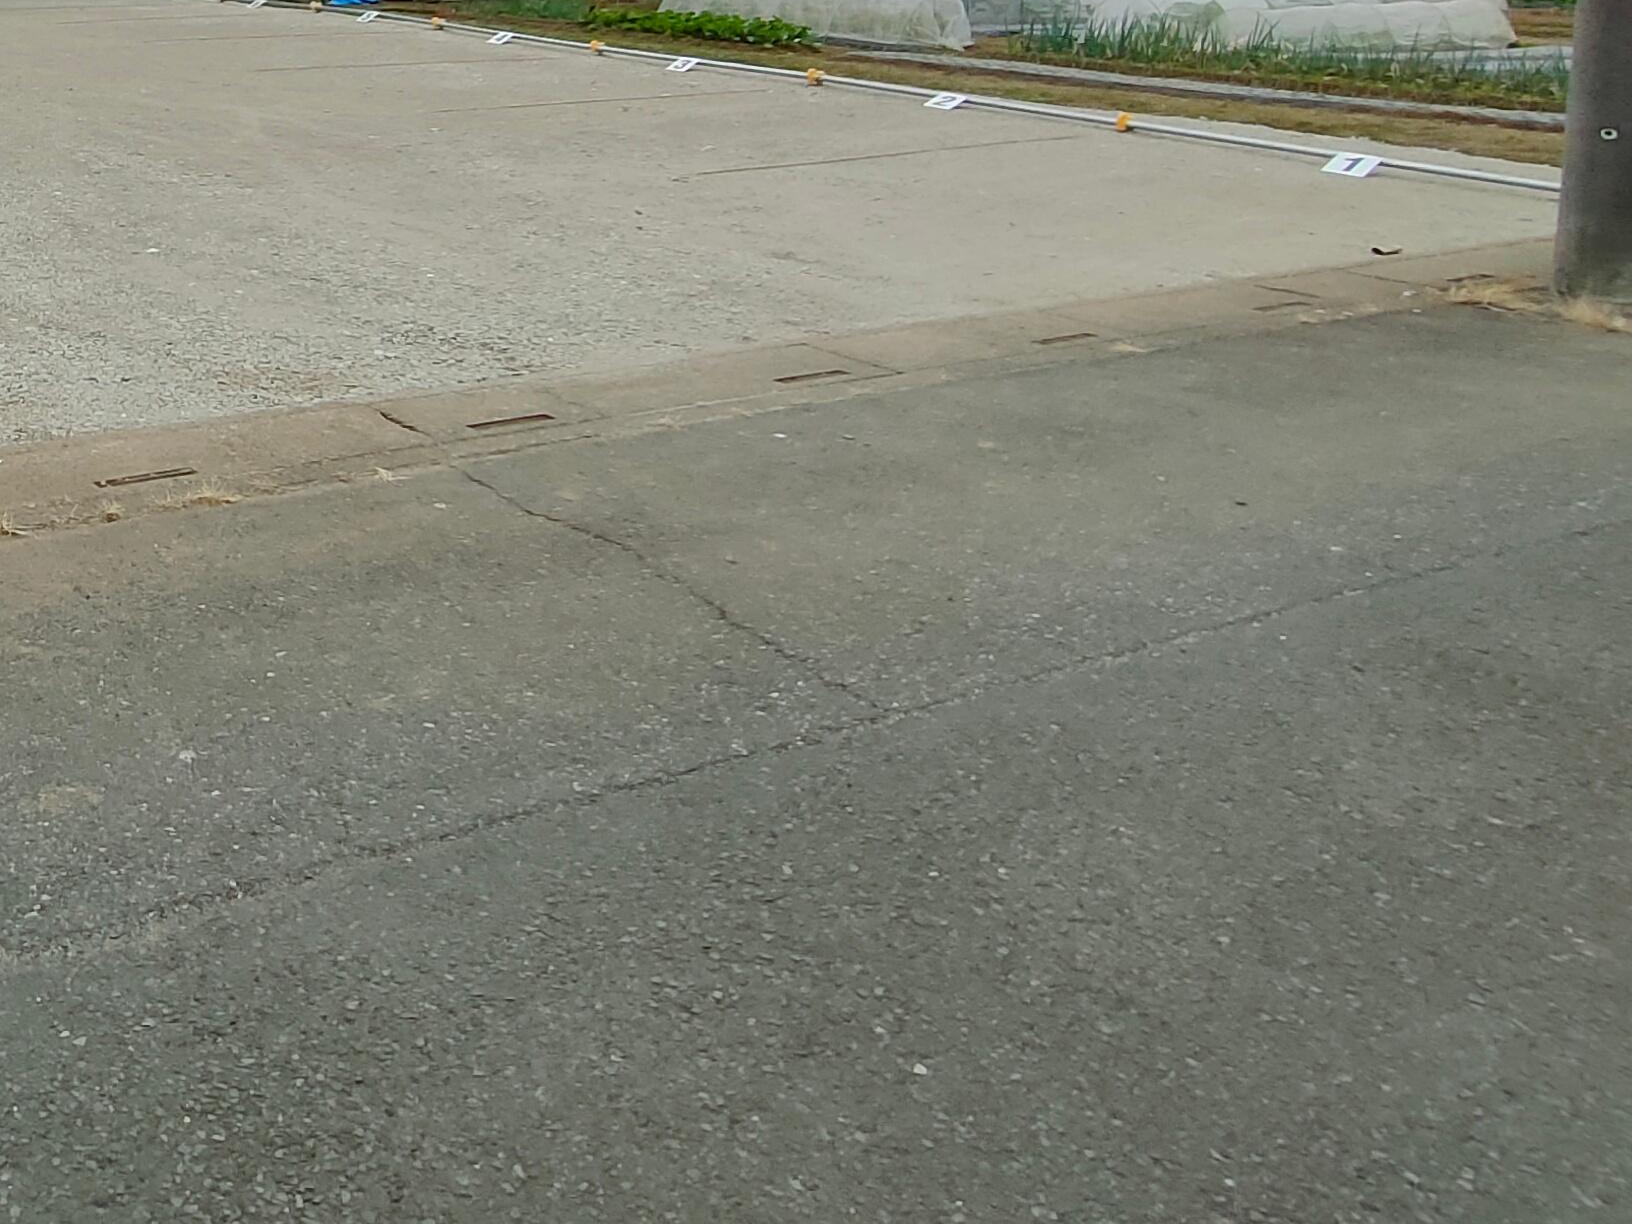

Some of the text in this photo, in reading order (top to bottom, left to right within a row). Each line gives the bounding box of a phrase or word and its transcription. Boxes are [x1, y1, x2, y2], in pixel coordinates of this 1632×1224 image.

[674, 59, 691, 69] 3
[932, 96, 957, 107] 2
[1342, 157, 1365, 172] 1
